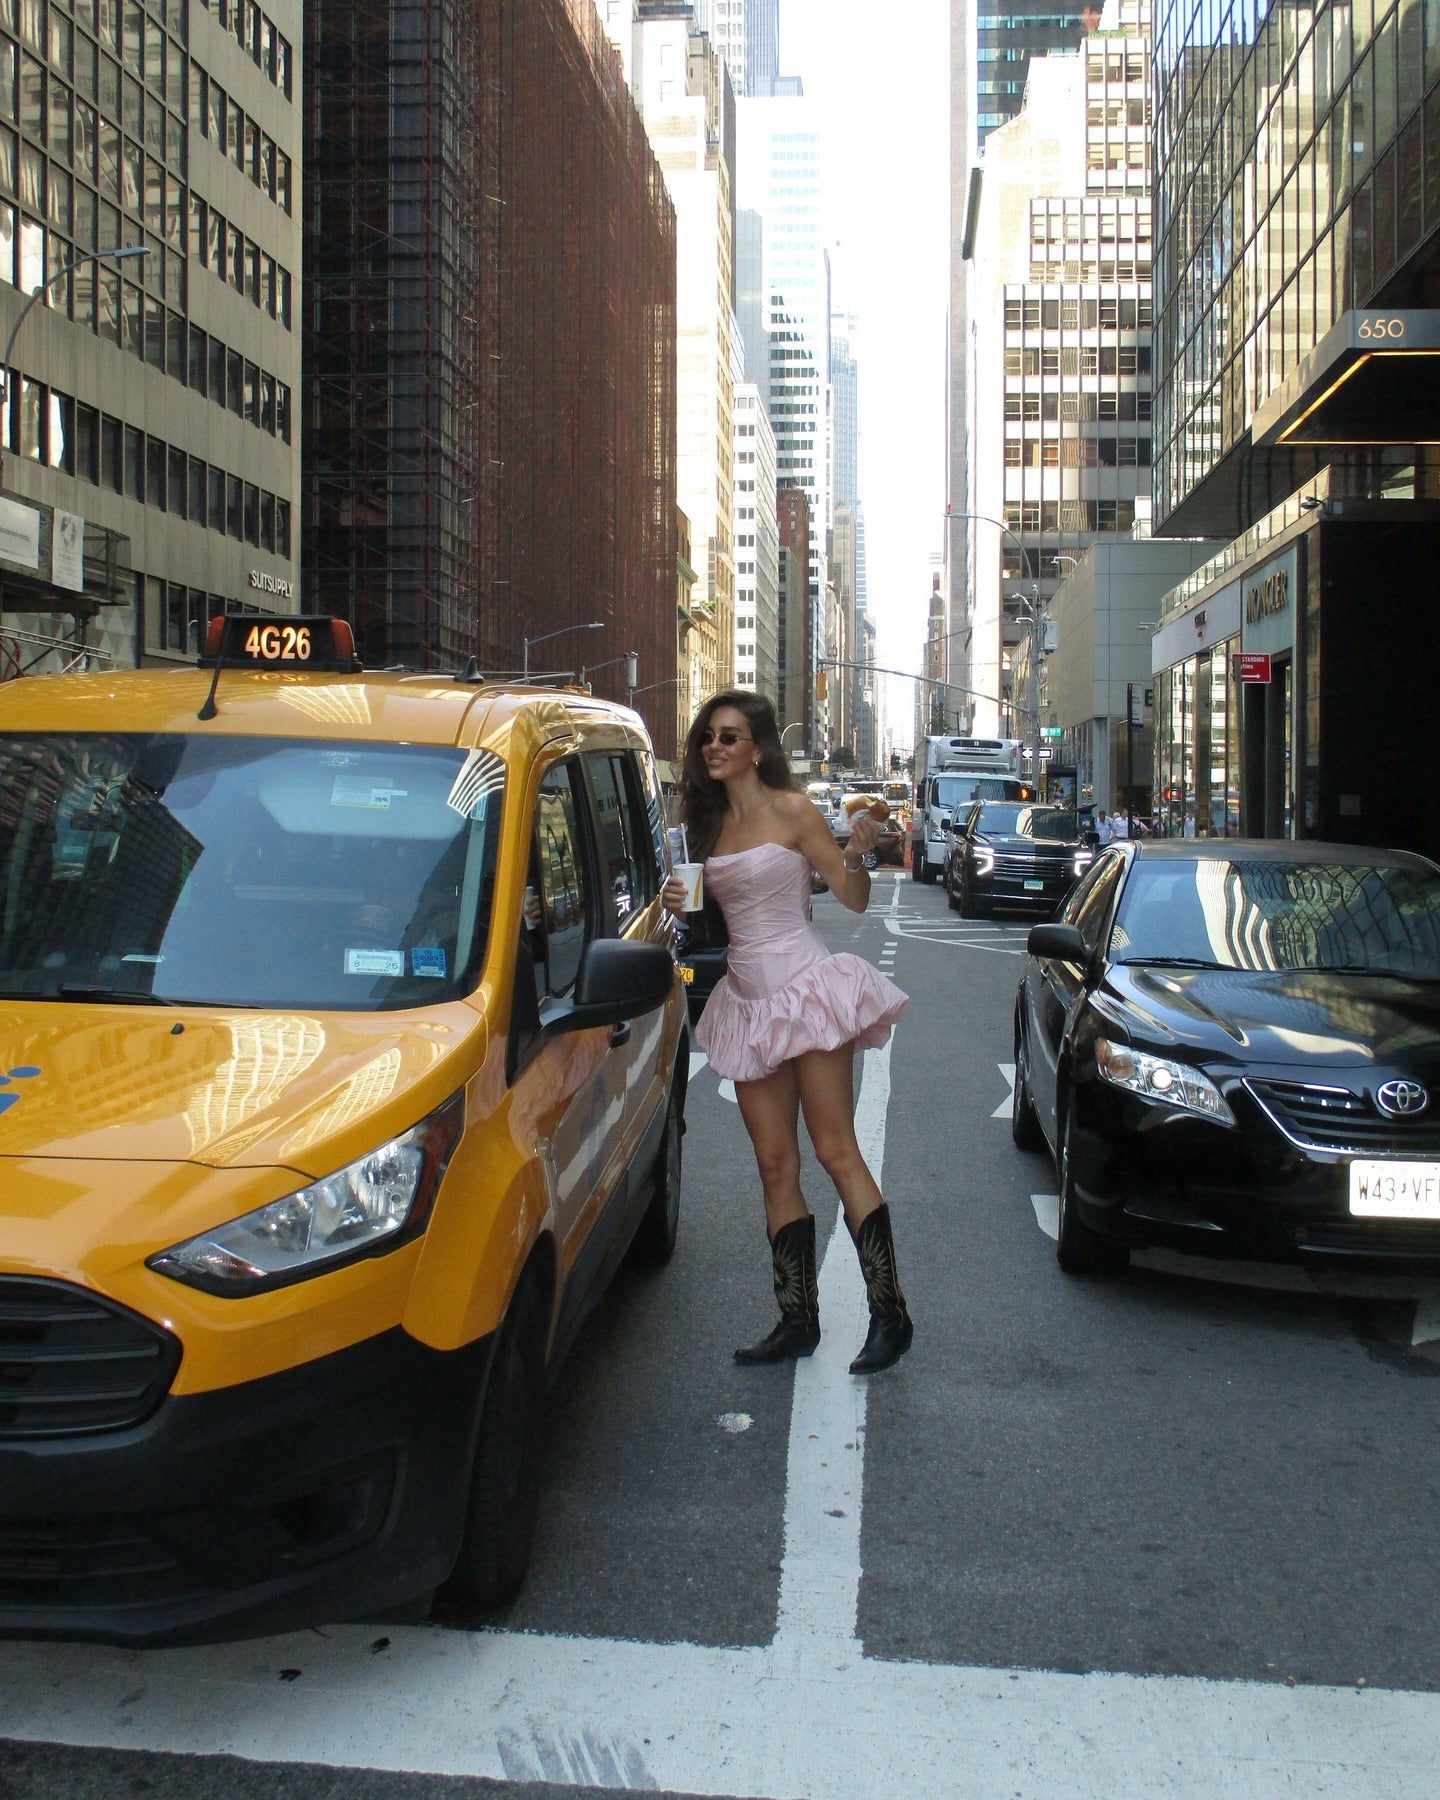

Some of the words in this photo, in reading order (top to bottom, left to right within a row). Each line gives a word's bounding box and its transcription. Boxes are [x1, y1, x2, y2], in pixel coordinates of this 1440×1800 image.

[1358, 318, 1404, 339] 650
[251, 570, 294, 598] SUITSUPPLY
[1246, 568, 1288, 624] MONCLER
[245, 625, 311, 661] 4G26
[385, 961, 399, 970] 25
[1358, 1175, 1396, 1202] W43
[1412, 1176, 1440, 1203] VF
